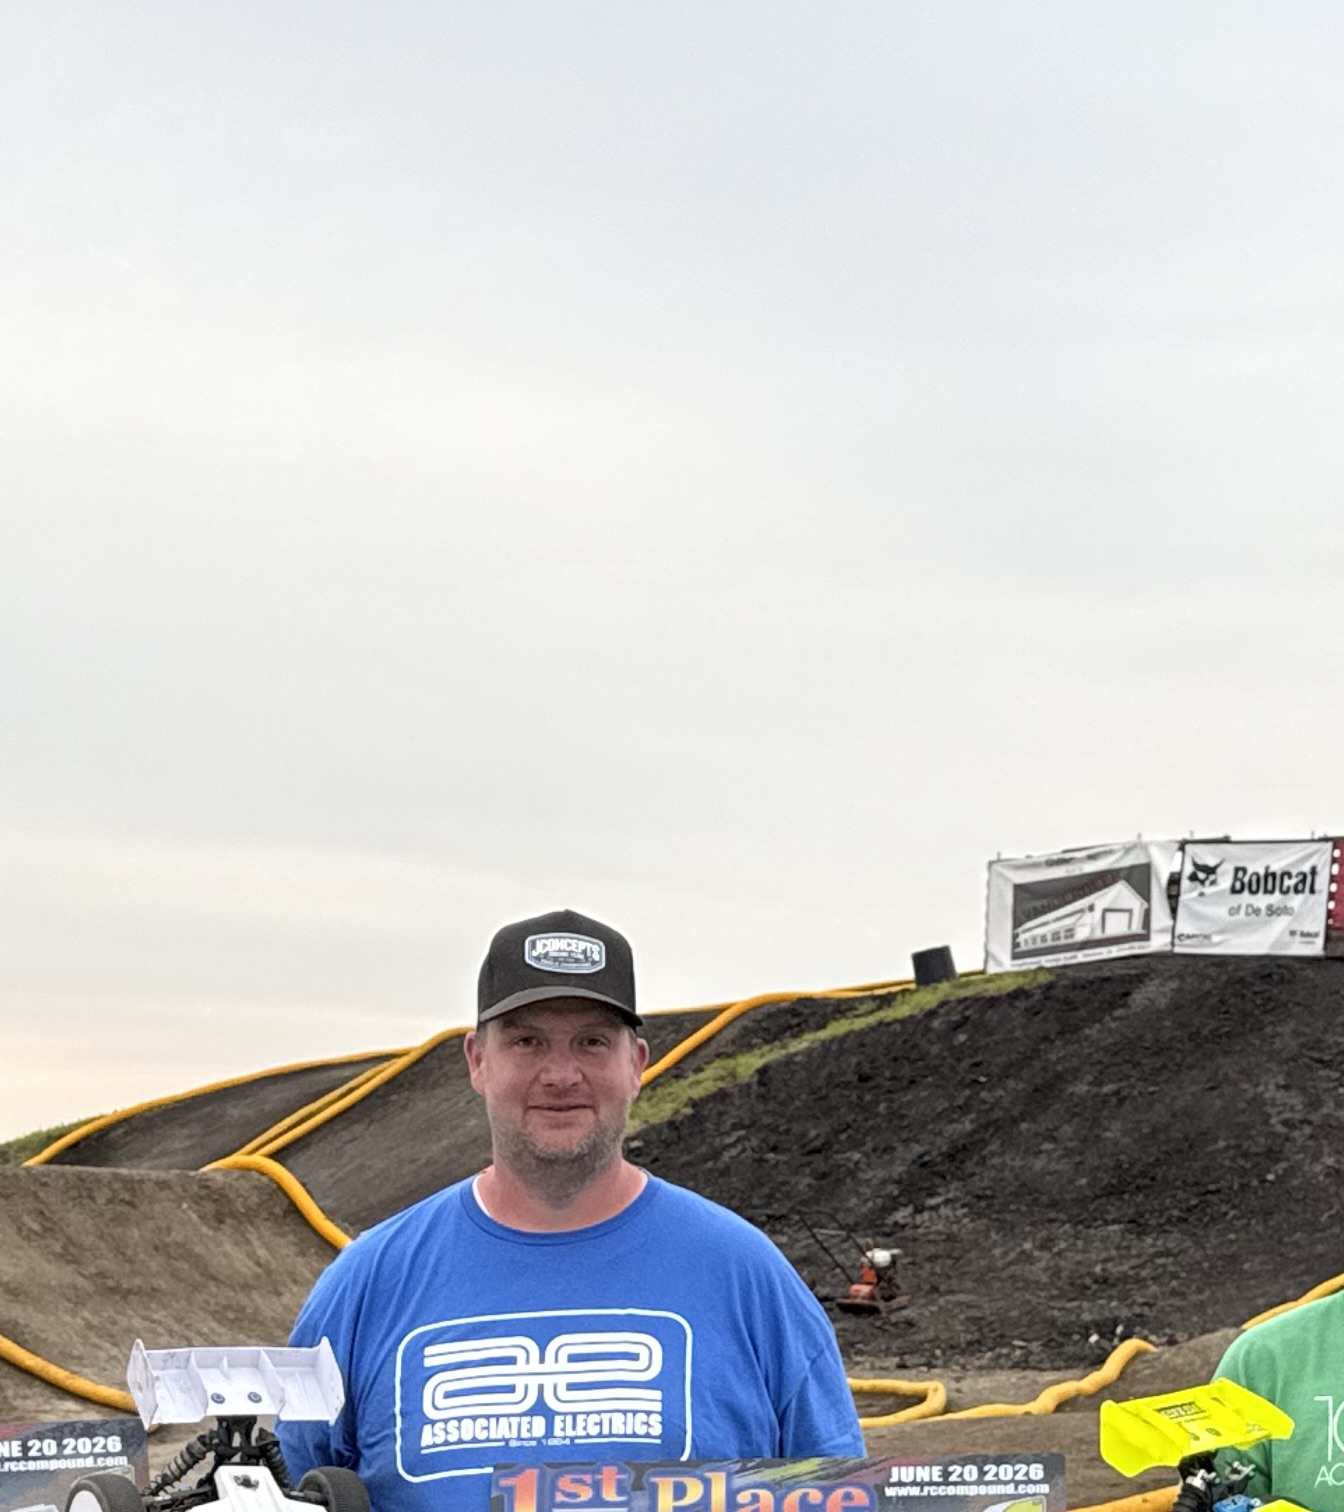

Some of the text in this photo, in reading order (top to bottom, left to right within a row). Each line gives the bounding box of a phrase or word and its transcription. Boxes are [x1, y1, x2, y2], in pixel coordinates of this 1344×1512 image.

[1230, 865, 1318, 895] Bobcat
[1228, 904, 1295, 917] of De Soto
[531, 937, 600, 961] JCONCEPTS
[421, 1412, 662, 1447] ASSOCIATED ELECTRICS
[27, 1439, 57, 1457] 20
[62, 1435, 122, 1455] 2026
[889, 1463, 1045, 1483] JUNE 20 2026
[884, 1482, 1050, 1497] www.rccompound.com
